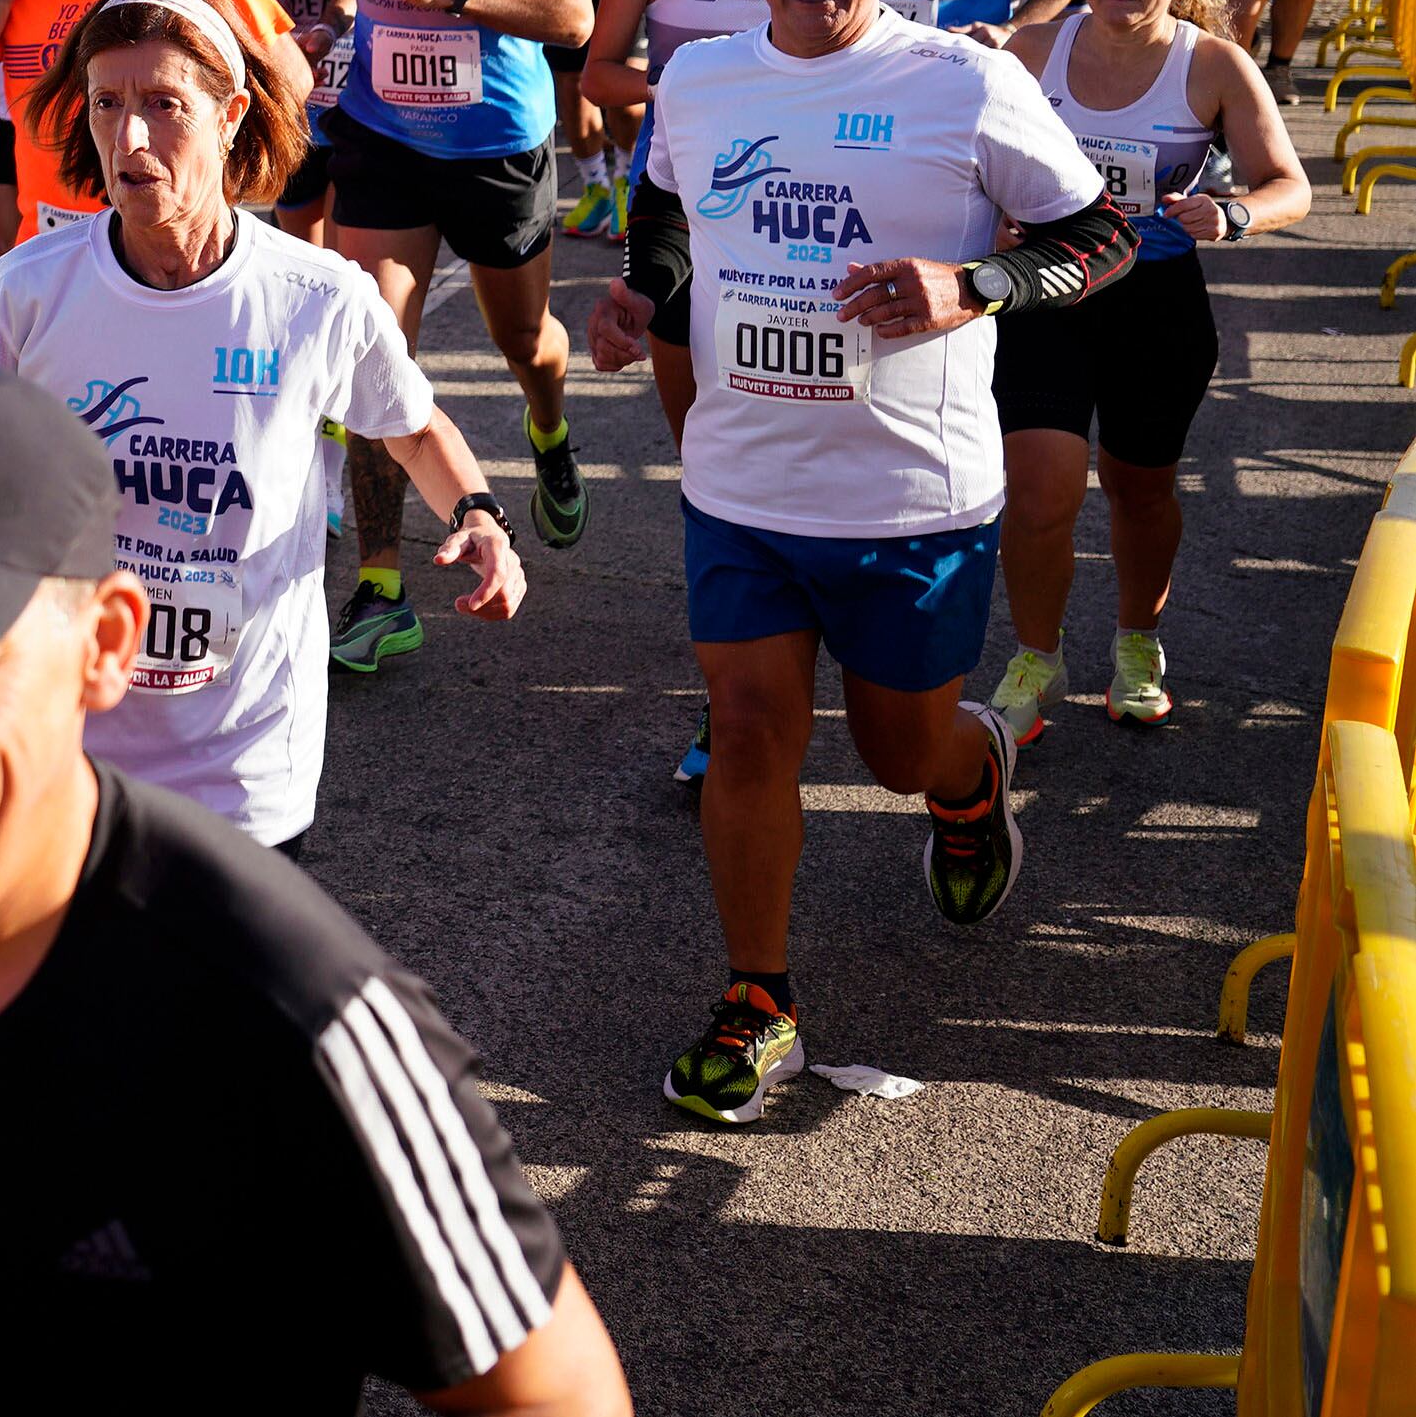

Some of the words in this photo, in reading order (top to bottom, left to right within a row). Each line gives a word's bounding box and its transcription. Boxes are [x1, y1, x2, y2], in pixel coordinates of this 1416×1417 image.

[57, 4, 79, 21] YO
[386, 30, 416, 40] CARRERA
[417, 31, 442, 42] HUCA
[443, 34, 463, 42] 2023
[410, 44, 435, 52] PACER
[392, 52, 458, 87] 0019
[415, 92, 430, 102] POR
[432, 92, 442, 101] LA
[444, 93, 469, 102] SALUD
[1081, 138, 1113, 151] HUCA
[1114, 142, 1138, 154] 2023
[765, 181, 854, 203] CARRERA
[49, 208, 81, 223] CARRERA
[752, 200, 874, 248] HUCA
[787, 244, 832, 264] 2023
[769, 275, 796, 290] POR
[799, 277, 817, 290] LA
[738, 292, 778, 308] CARRERA
[780, 297, 817, 314] HUCA
[767, 314, 809, 328] JAVIER
[736, 322, 844, 379] 0006
[772, 386, 795, 397] POR
[797, 387, 811, 397] LA
[814, 387, 850, 399] SALUD
[129, 434, 237, 466] CARRERA
[113, 458, 253, 517] HUCA
[157, 506, 209, 536] 2023
[135, 537, 163, 563] POR
[165, 546, 187, 564] LA
[190, 548, 239, 565] SALUD
[139, 563, 183, 584] HUCA
[183, 569, 217, 584] 2023
[145, 604, 213, 663] 08
[153, 671, 172, 687] LA
[173, 668, 213, 687] SALUD
